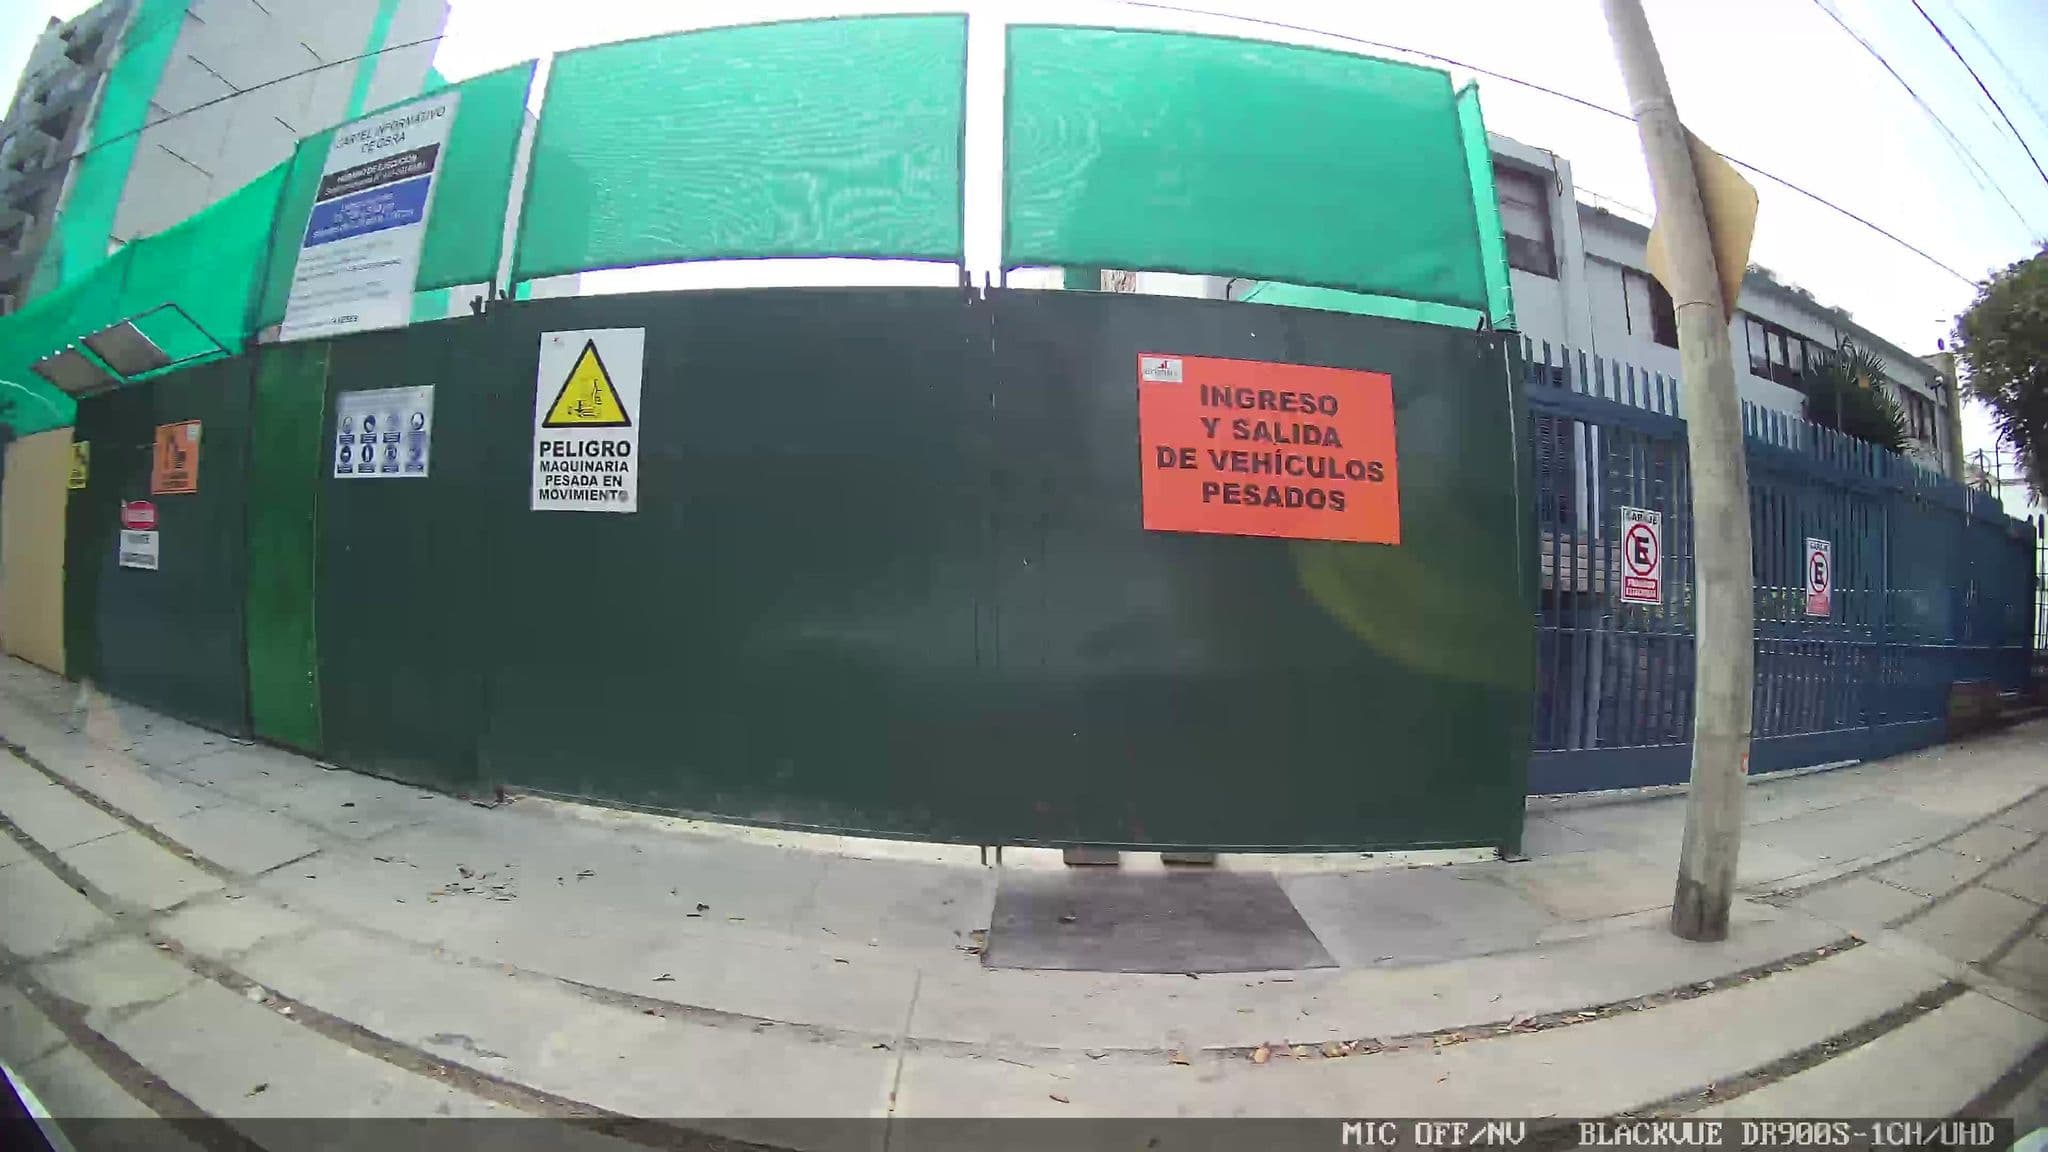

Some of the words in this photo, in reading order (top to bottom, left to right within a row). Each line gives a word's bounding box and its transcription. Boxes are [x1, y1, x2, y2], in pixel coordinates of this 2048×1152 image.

[373, 105, 446, 134] INFORMATIVO
[1200, 384, 1339, 417] INGRESO
[1200, 416, 1221, 438] Y
[1232, 418, 1343, 448] SALIDA
[539, 440, 631, 458] PELIGRO
[1156, 445, 1198, 470] DE
[1208, 449, 1386, 482] VEHÍCULOS
[540, 460, 629, 473] MAQUINARIA
[545, 475, 598, 487] PESADA
[603, 475, 623, 487] EN
[539, 489, 629, 502] MOVIMIENTO
[1202, 481, 1346, 512] PESADOS
[1634, 536, 1650, 565] E
[1815, 562, 1824, 584] E
